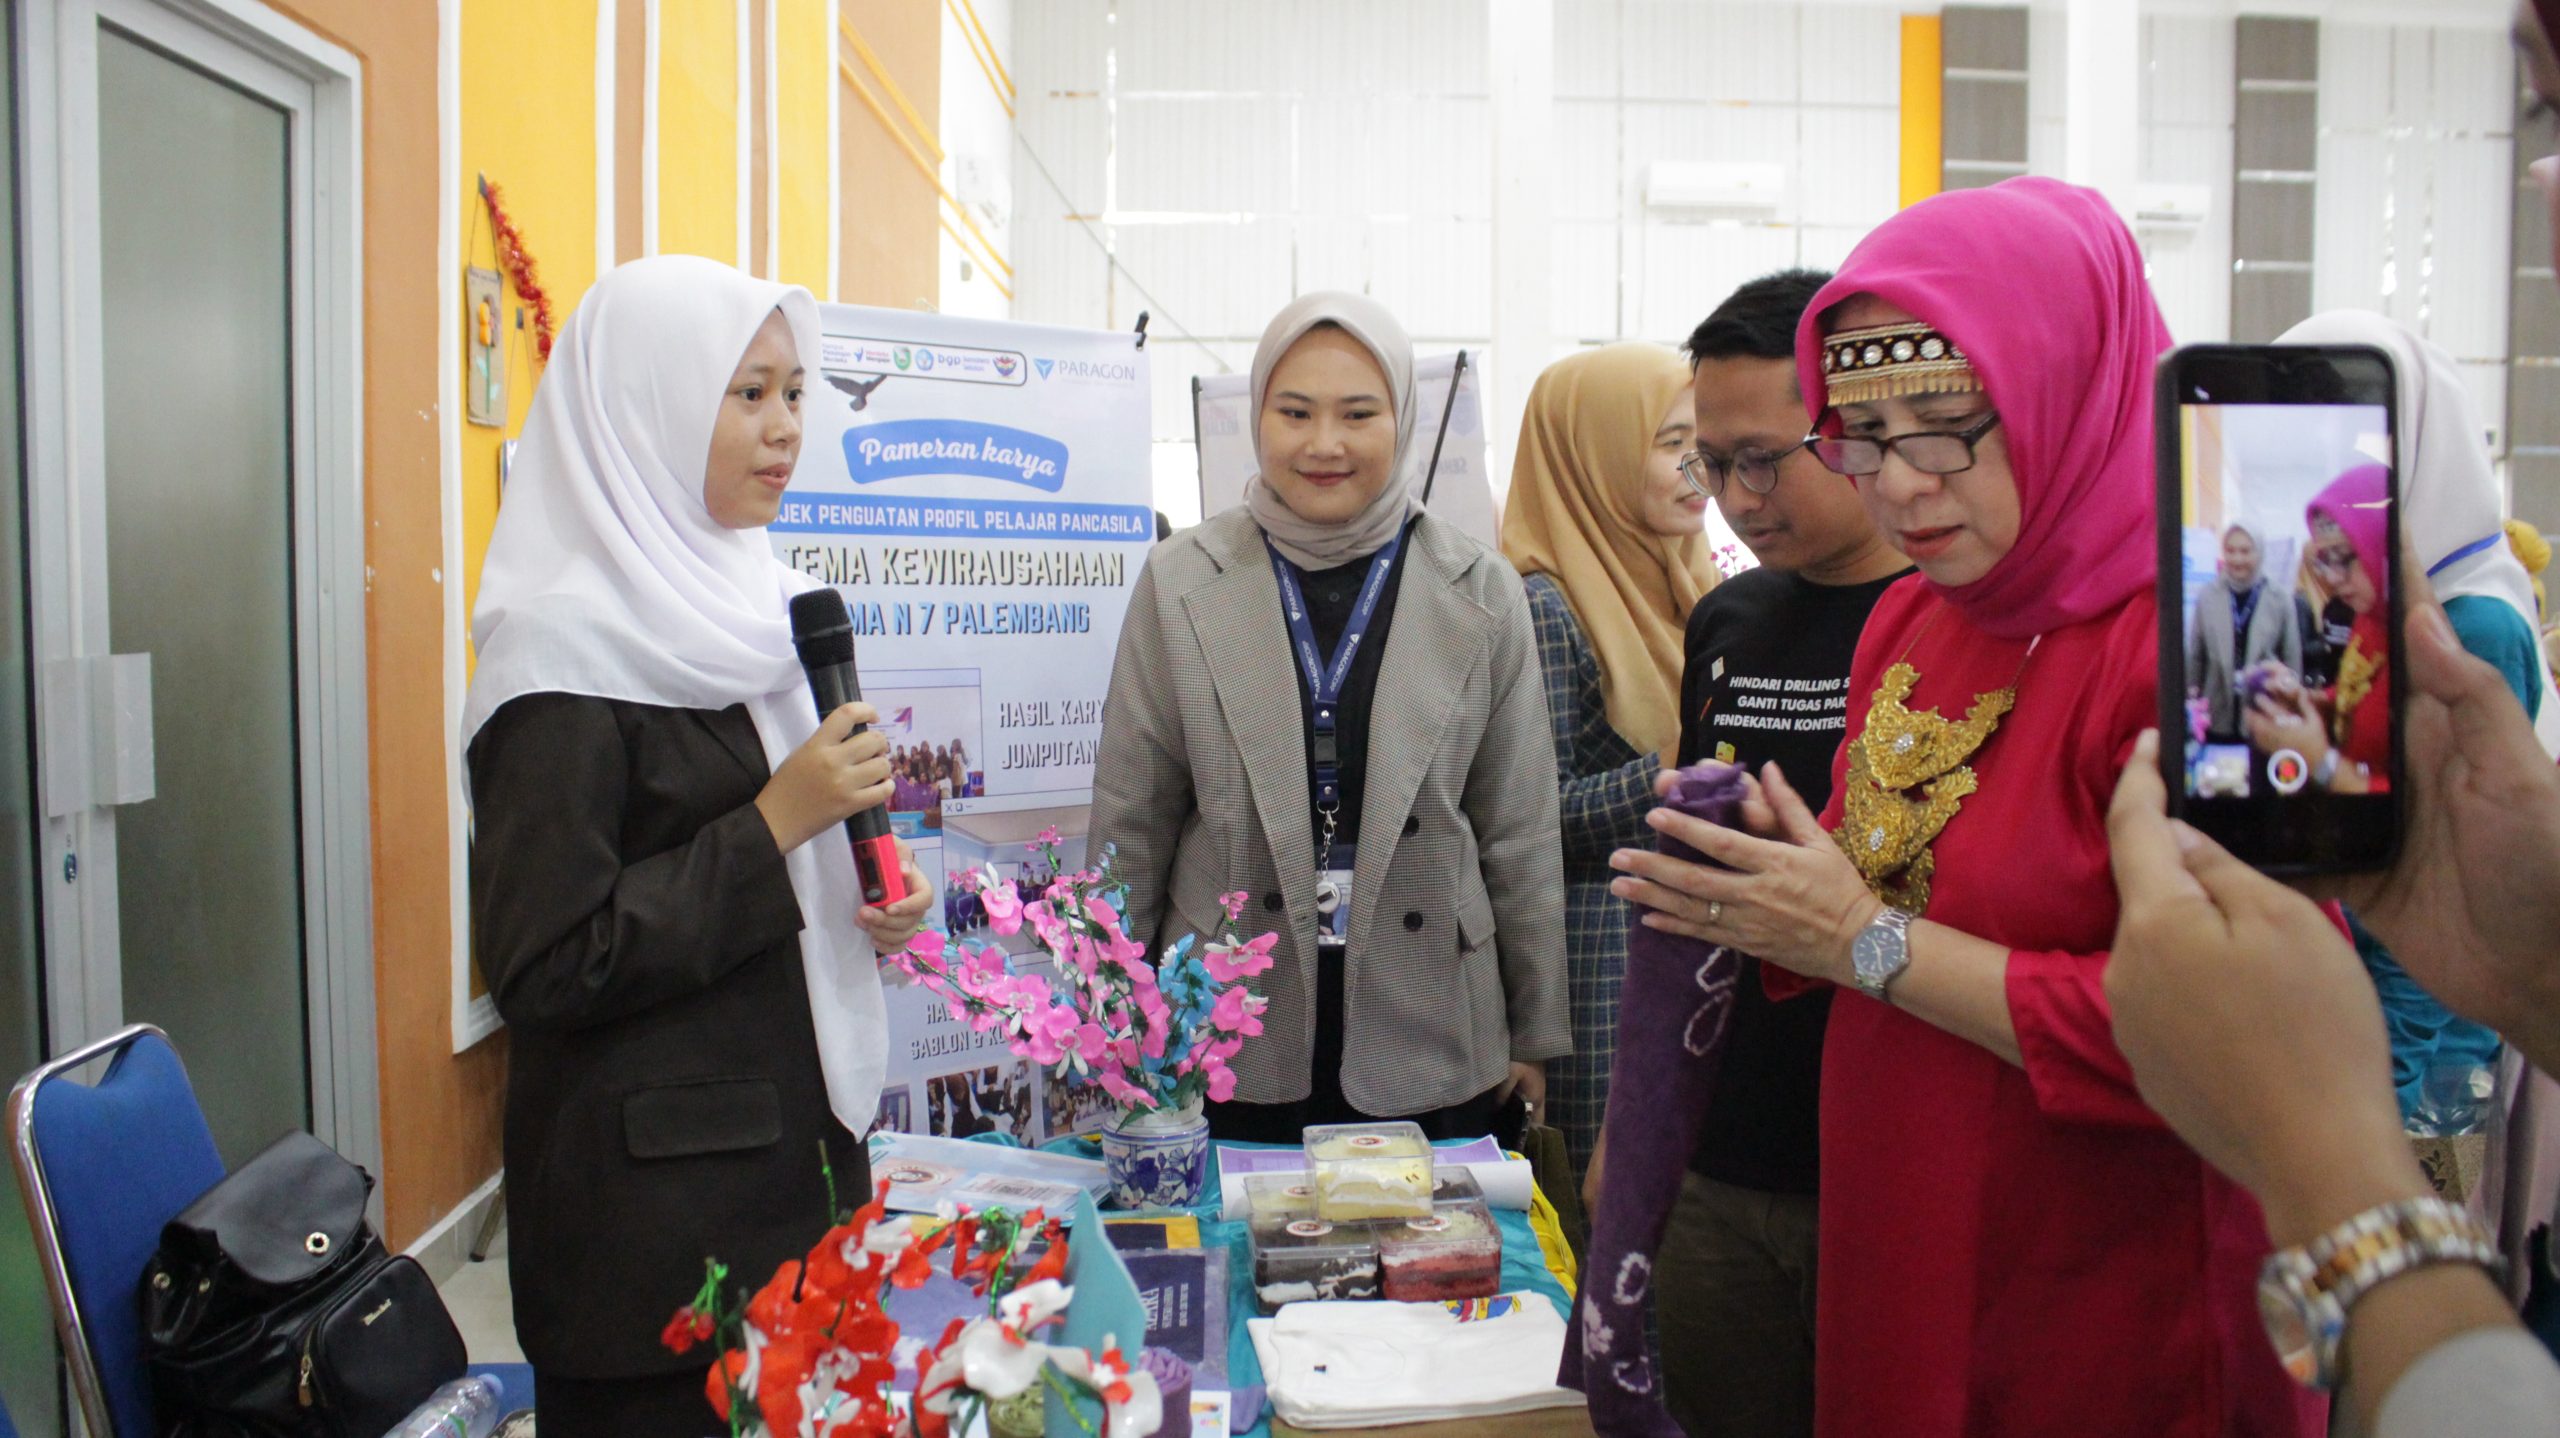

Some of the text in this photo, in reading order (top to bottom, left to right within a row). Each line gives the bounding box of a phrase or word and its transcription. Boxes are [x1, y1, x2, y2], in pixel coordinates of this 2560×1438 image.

[1058, 359, 1135, 381] PARAGON
[858, 437, 1057, 480] Pameran karya
[774, 503, 1144, 534] JEK PENGUATAN PROFIL PELAJAR PANCASILA
[784, 544, 1125, 587] TEMA KEWIRAUSAHAAN
[845, 601, 1090, 636] MA N 7 PALEMBANG
[1729, 676, 1781, 691] HINDARI
[1784, 678, 1841, 692] DRILLING
[1000, 699, 1105, 729] HASIL KARY
[1737, 695, 1848, 711] GANTI TUGAS PAK
[1713, 714, 1846, 731] PENDEKATAN KONTEKS
[1001, 740, 1097, 770] JUMPUTAN
[927, 1002, 956, 1025] HA
[911, 1031, 970, 1061] SABLON
